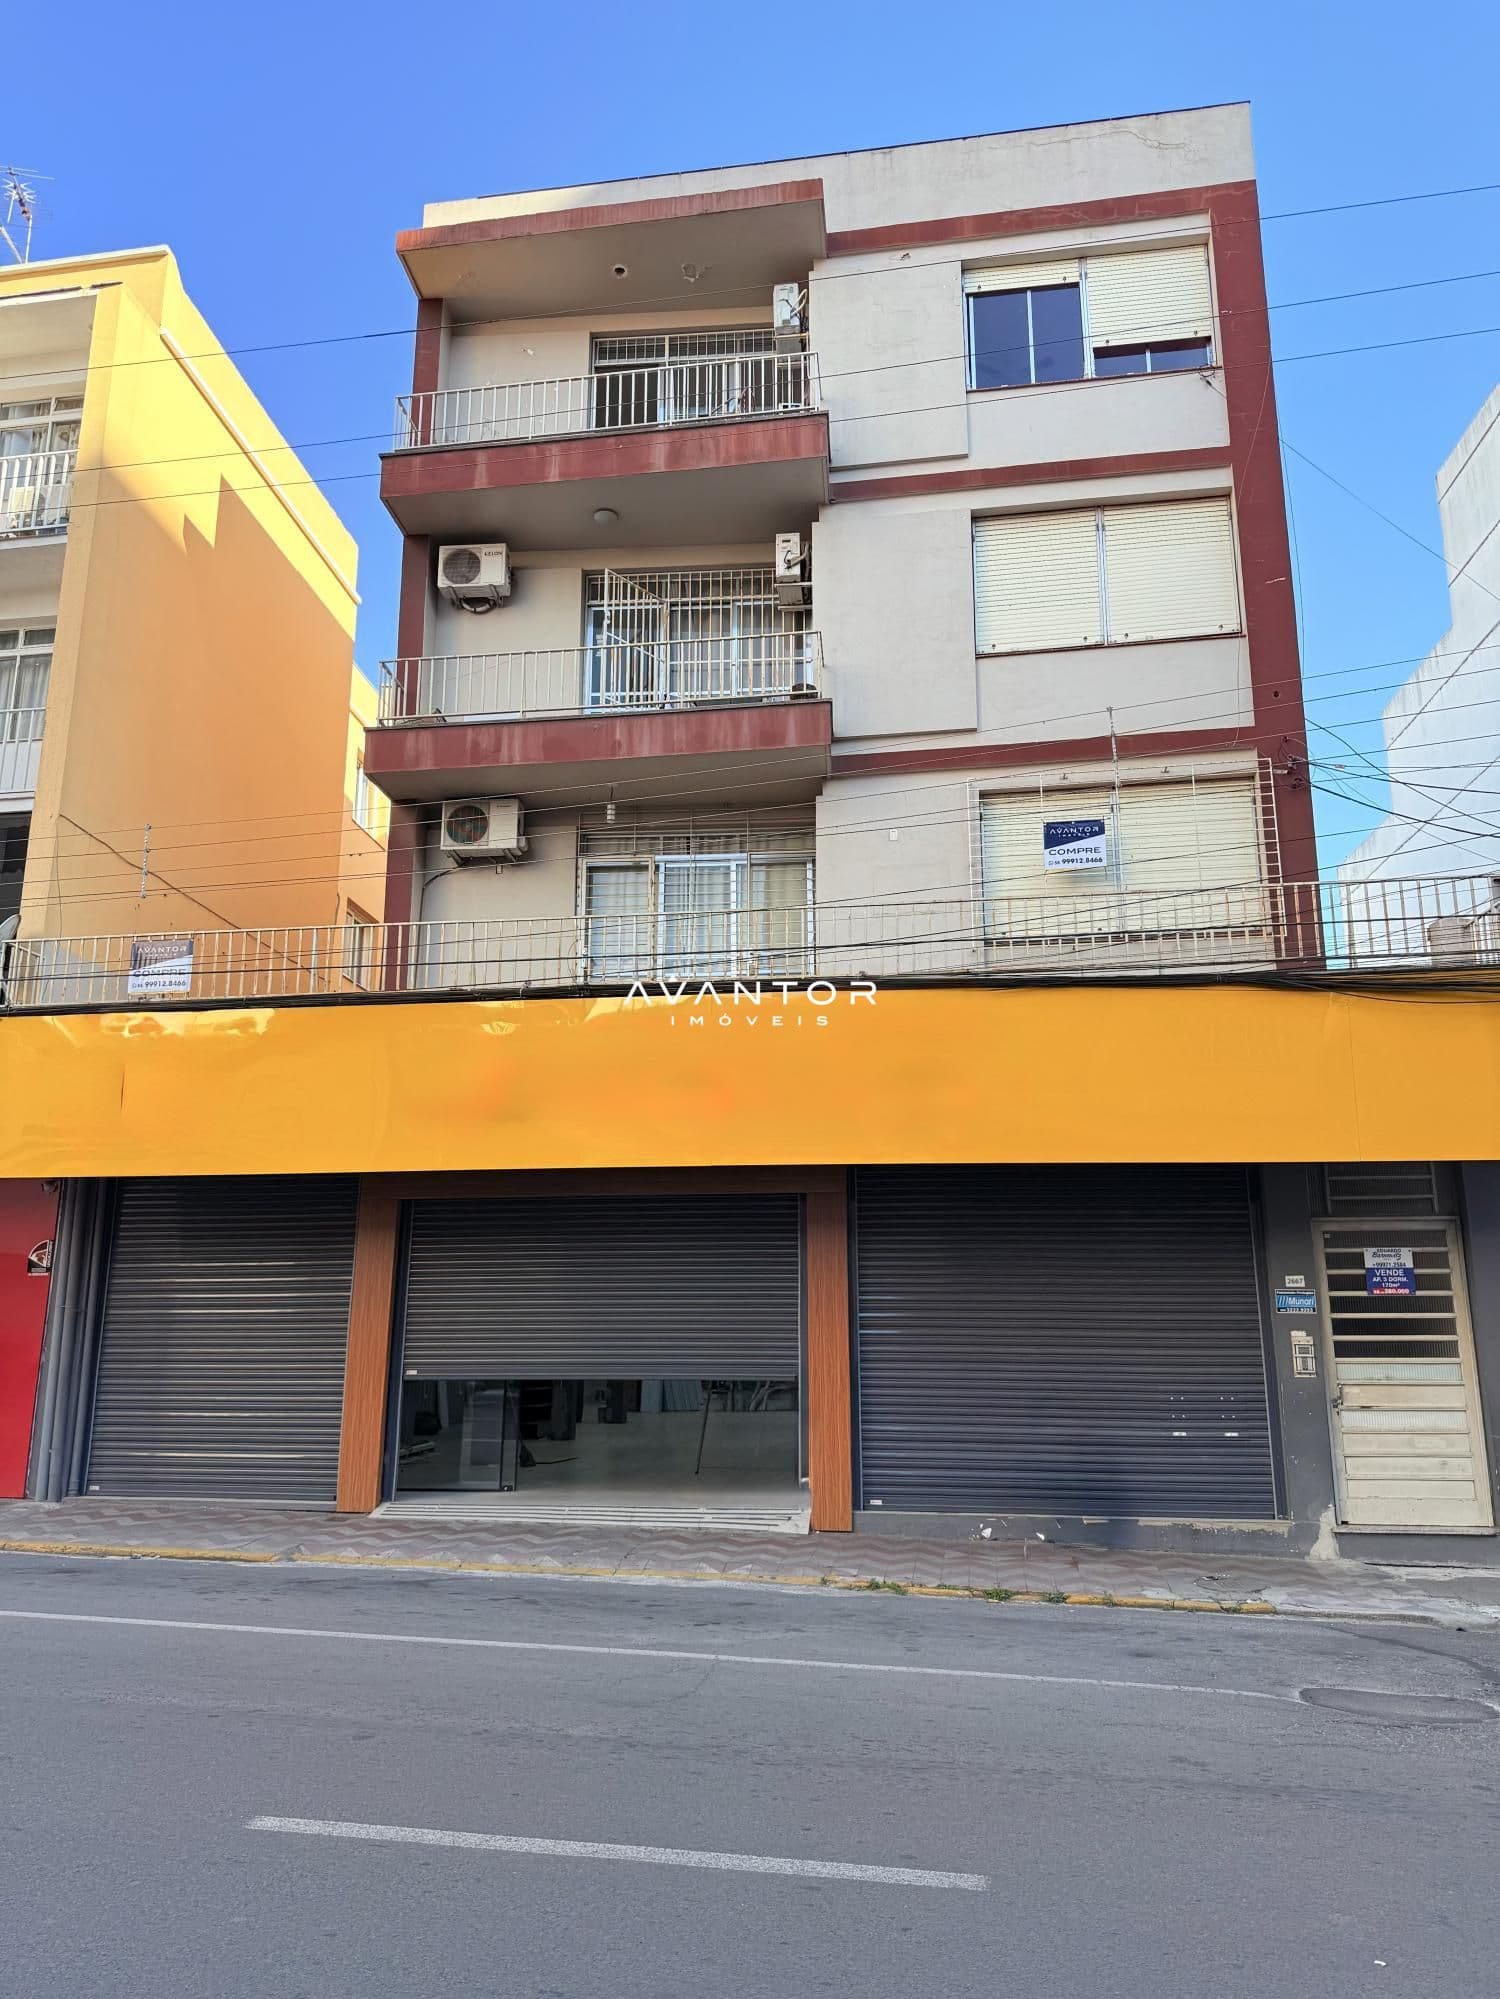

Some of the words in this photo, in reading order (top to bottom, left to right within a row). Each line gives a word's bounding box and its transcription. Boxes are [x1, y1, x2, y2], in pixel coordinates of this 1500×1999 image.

[1049, 826, 1099, 834] AVANTOR
[1049, 847, 1101, 855] COMPRE
[1062, 857, 1103, 865] 99912.8466
[138, 945, 187, 954] AVANTOR
[1288, 1297, 1314, 1305] Munari
